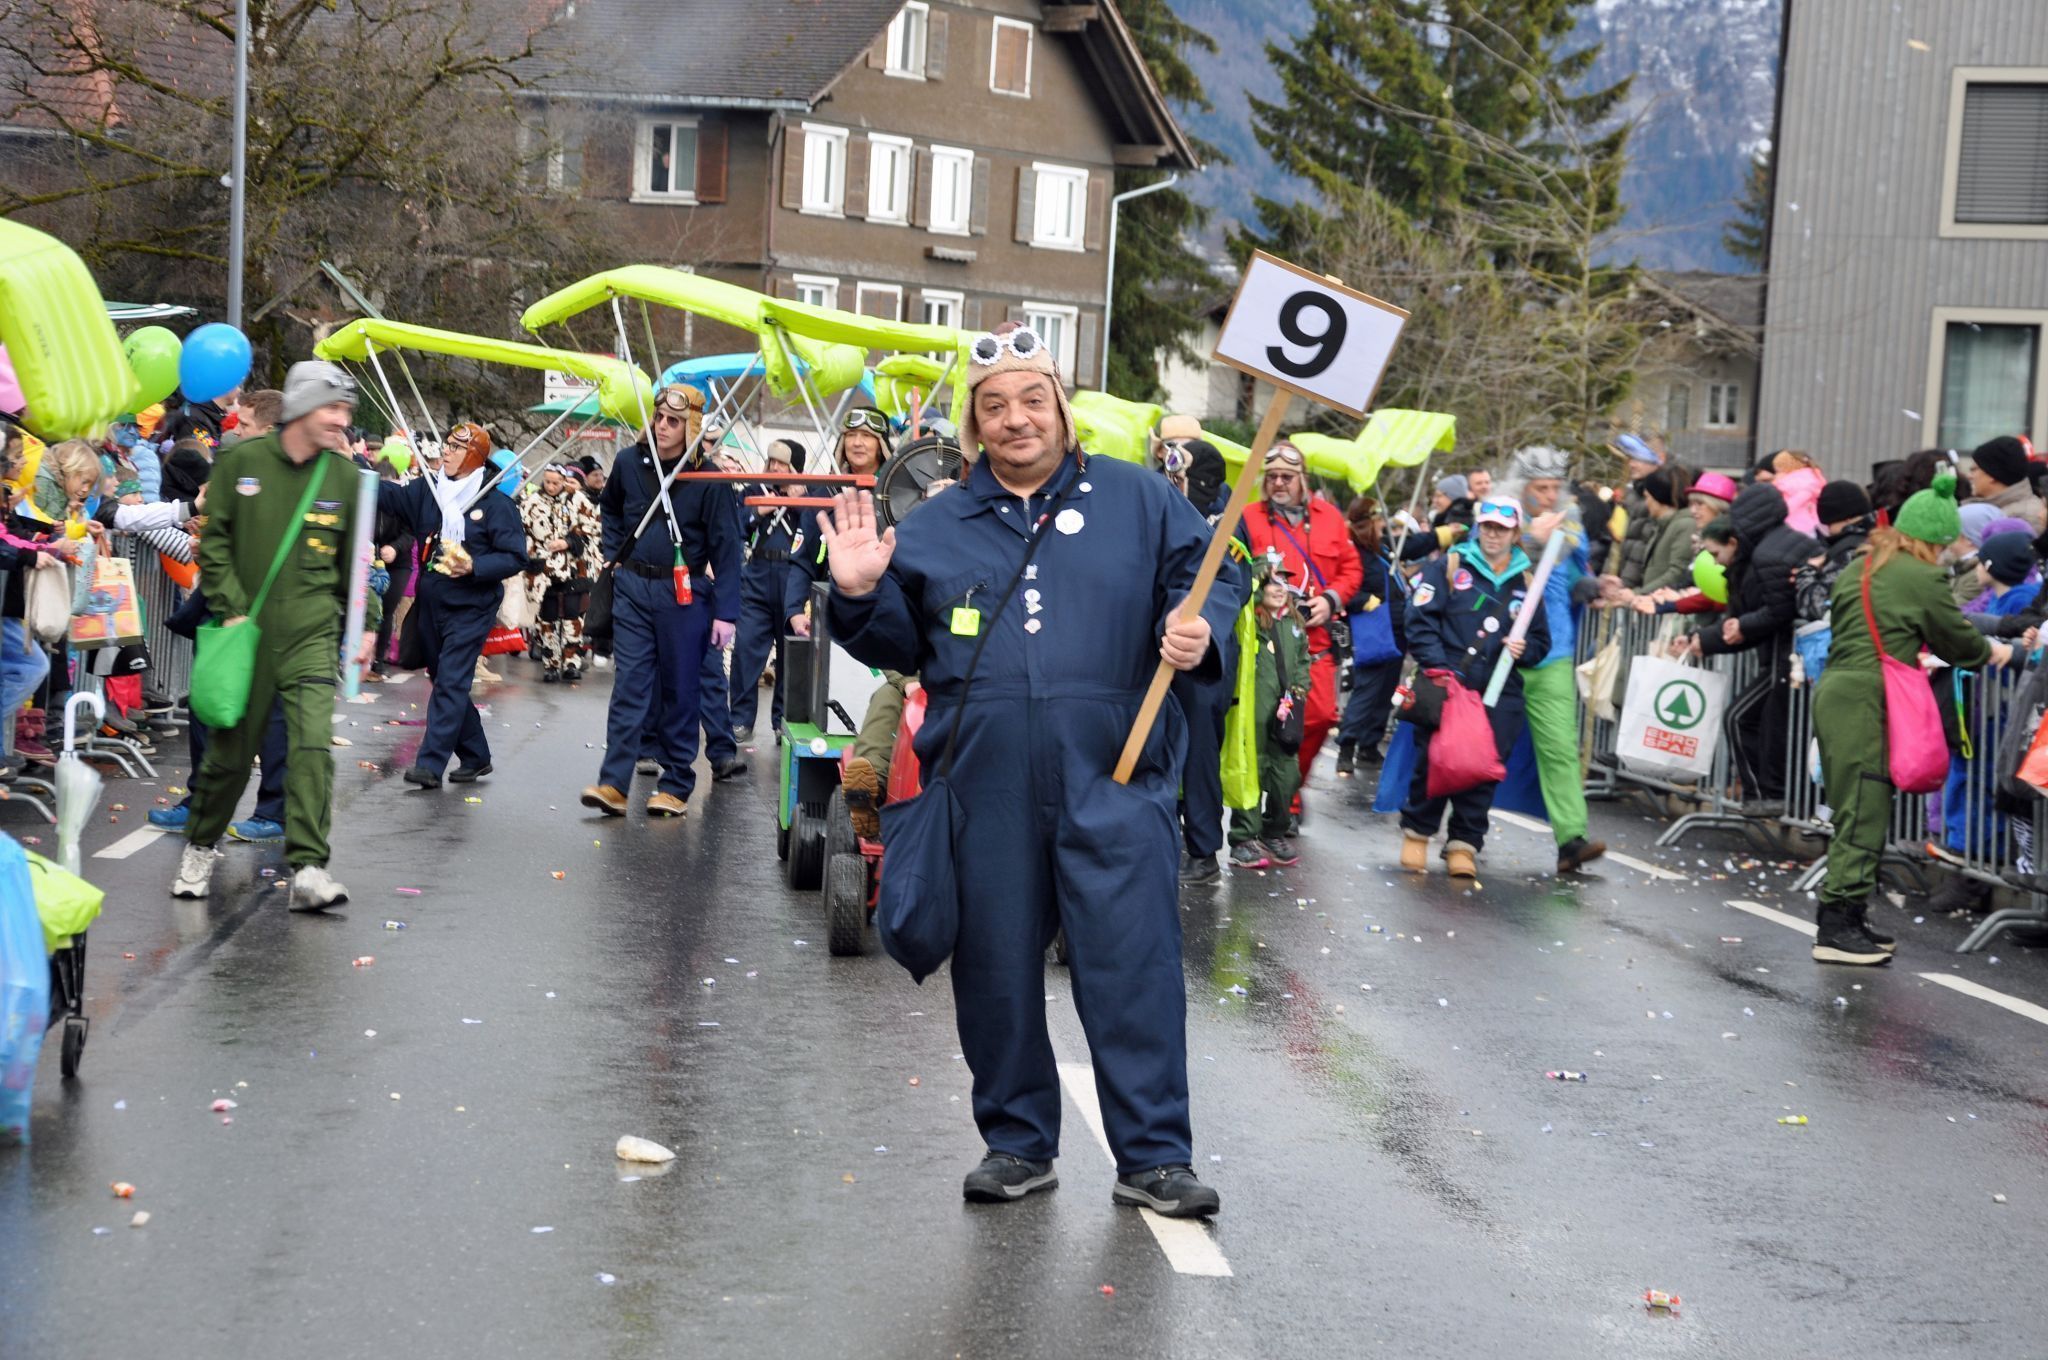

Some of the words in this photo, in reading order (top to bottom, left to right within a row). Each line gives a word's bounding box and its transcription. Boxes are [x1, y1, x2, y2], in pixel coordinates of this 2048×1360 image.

[1266, 290, 1348, 379] 9
[1644, 737, 1695, 757] SPAR
[1646, 727, 1697, 748] EURO
